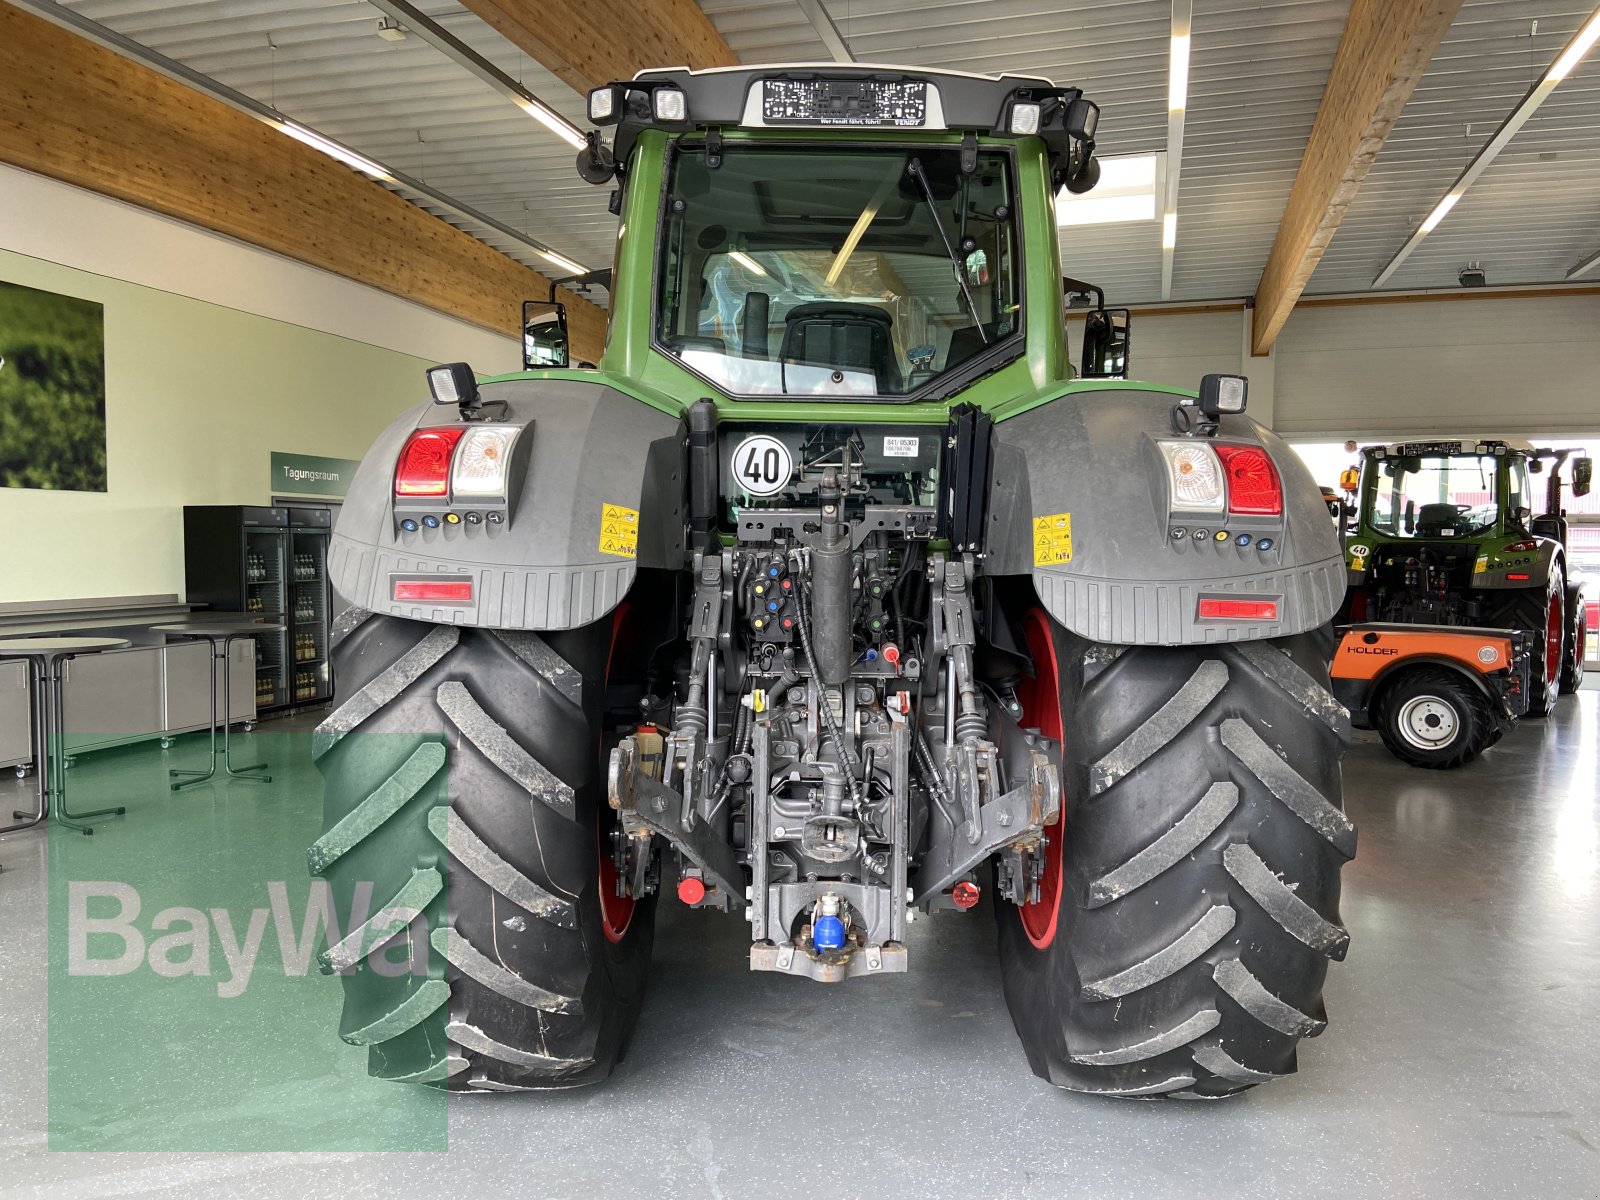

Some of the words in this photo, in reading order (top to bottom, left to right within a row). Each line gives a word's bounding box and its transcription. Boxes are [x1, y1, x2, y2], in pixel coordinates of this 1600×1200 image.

[743, 447, 780, 485] 40
[283, 465, 340, 482] Tagungsraum
[1353, 545, 1367, 555] 40
[1347, 646, 1399, 656] HOLDER
